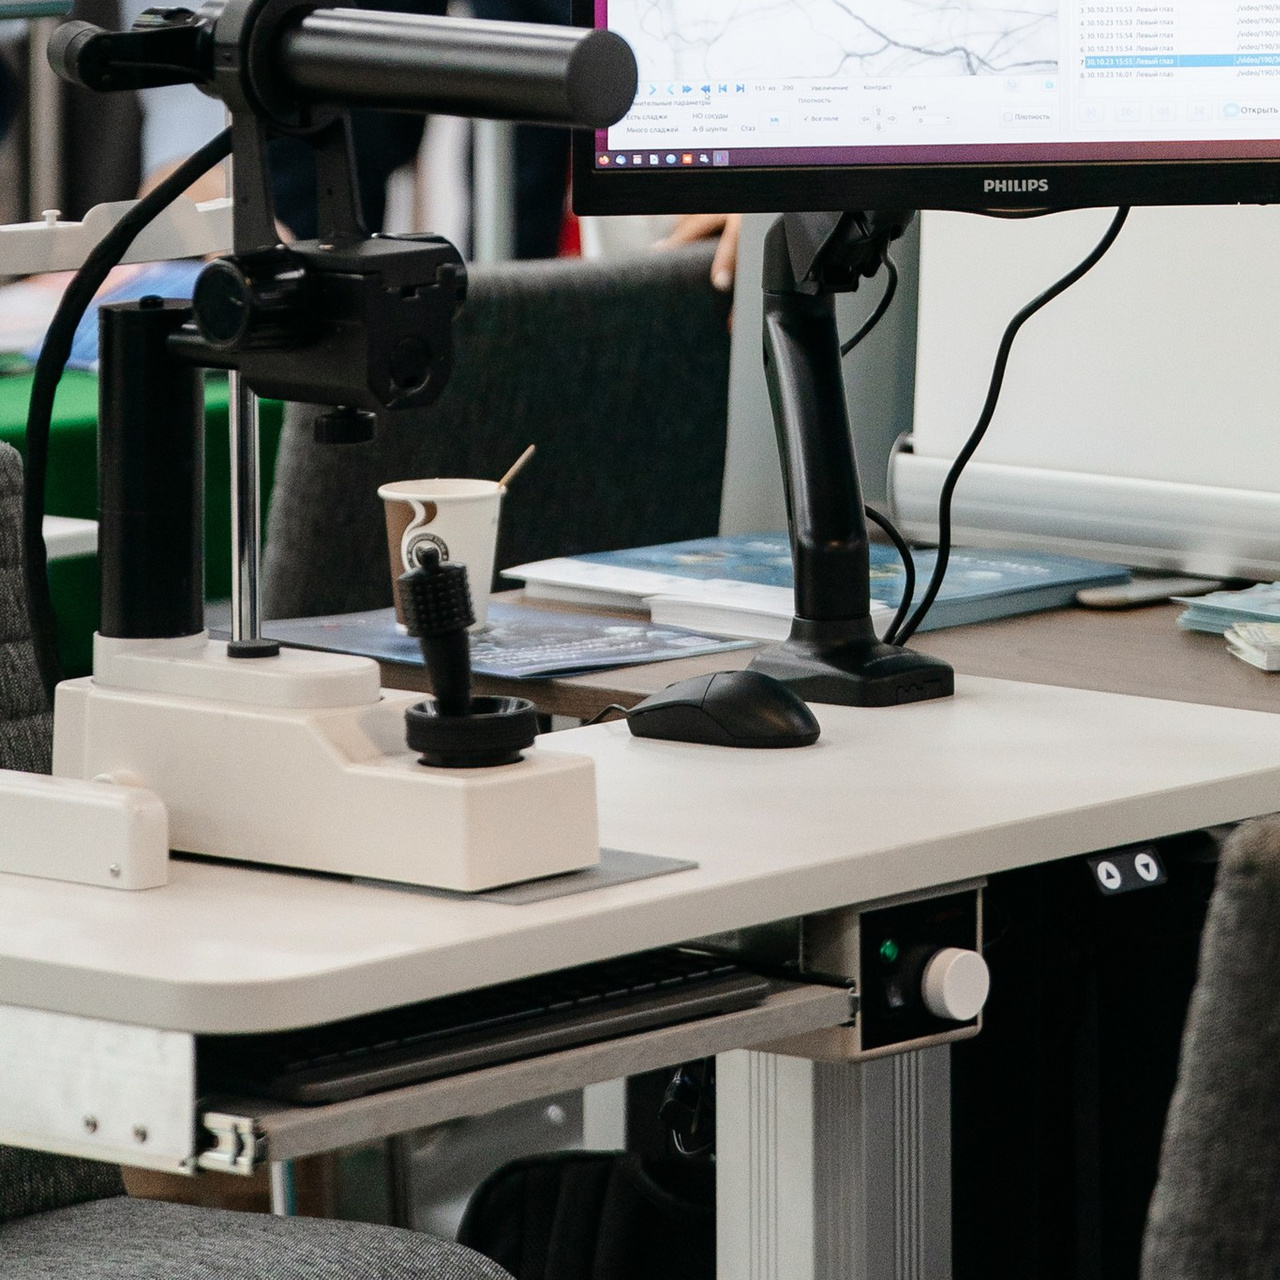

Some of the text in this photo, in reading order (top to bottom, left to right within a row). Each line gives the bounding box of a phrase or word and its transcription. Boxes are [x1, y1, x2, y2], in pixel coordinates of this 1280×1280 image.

[1239, 105, 1280, 117] Открыть
[1014, 113, 1051, 122] Плотность
[983, 178, 1049, 193] PHILIPS
